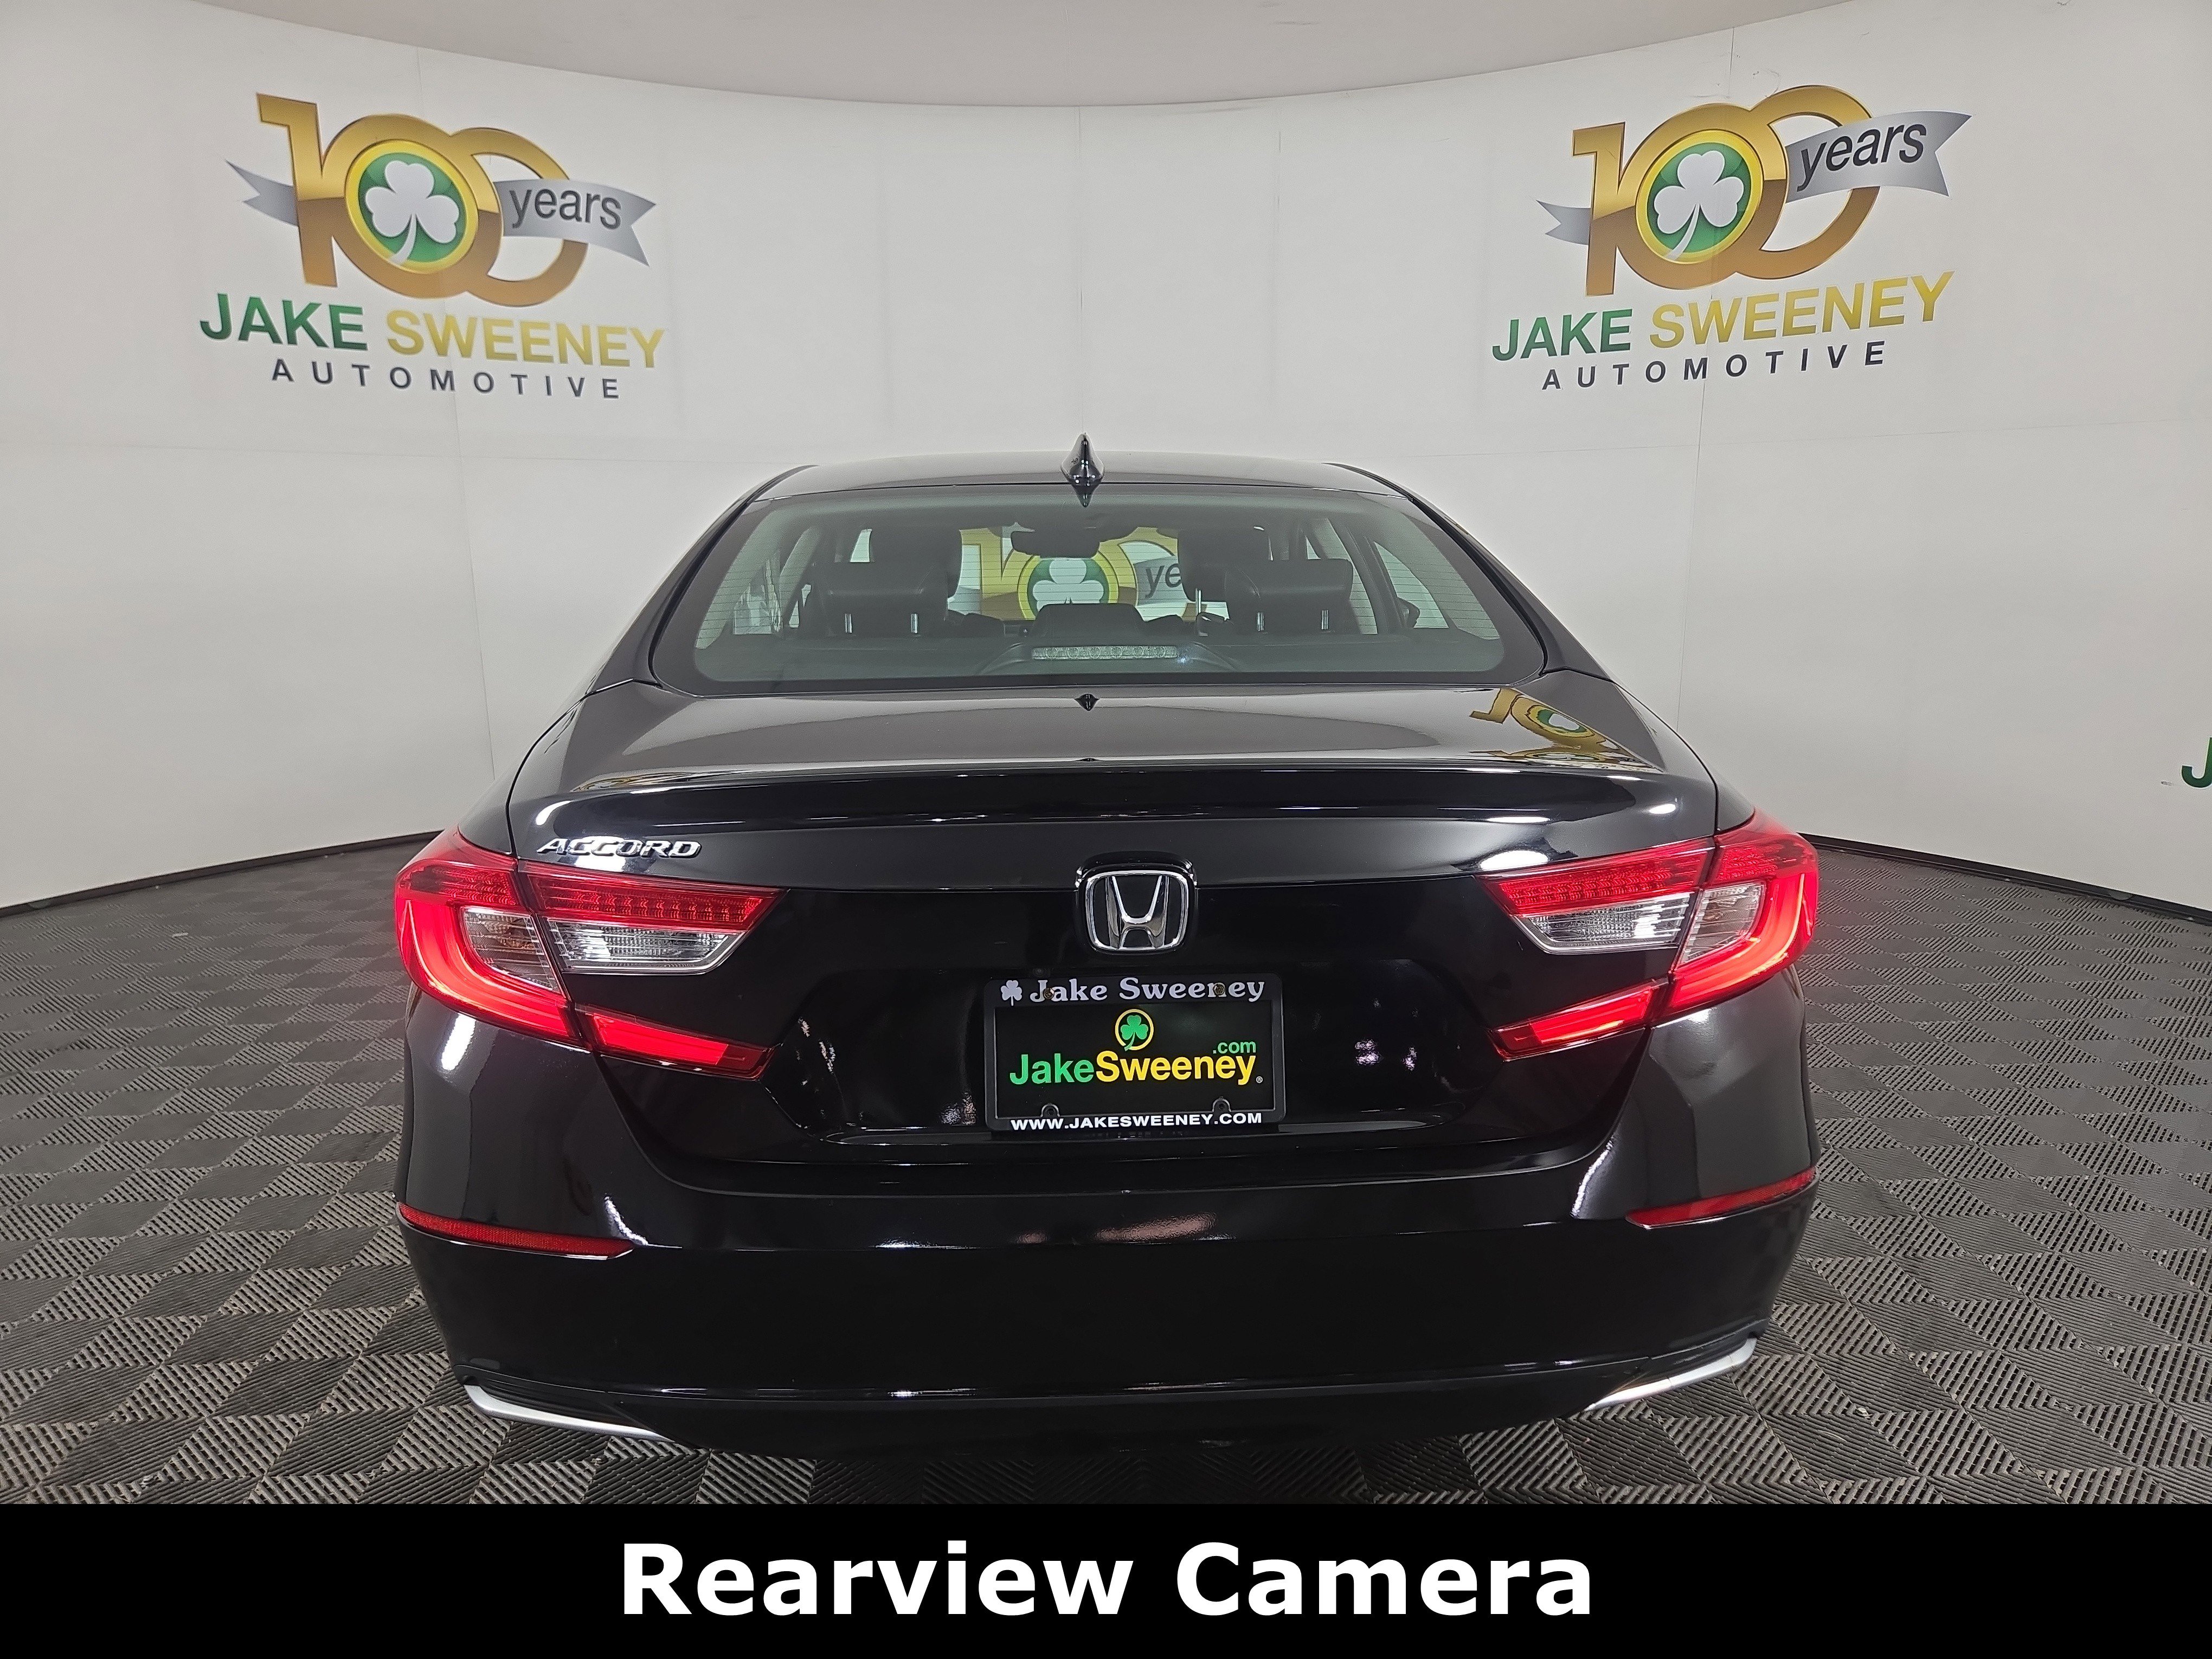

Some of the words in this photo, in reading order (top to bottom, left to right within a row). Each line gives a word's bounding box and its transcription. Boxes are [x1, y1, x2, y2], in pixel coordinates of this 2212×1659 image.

[1797, 123, 1927, 192] years
[256, 93, 588, 307] 100
[509, 188, 622, 229] years
[1572, 85, 1881, 297] 100
[199, 293, 368, 351] JAKE
[387, 310, 665, 368] SWEENEY
[1492, 308, 1632, 361] JAKE
[1650, 271, 1956, 349] SWEENEY
[272, 358, 619, 399] AUTOMOTIVE
[1542, 340, 1886, 390] AUTOMOTIVE
[537, 837, 702, 858] ACCORD
[1030, 978, 1108, 1002] Jake
[1213, 1040, 1256, 1054] .com
[1011, 1113, 1262, 1130] WWW.JAKESWEENEY.COM
